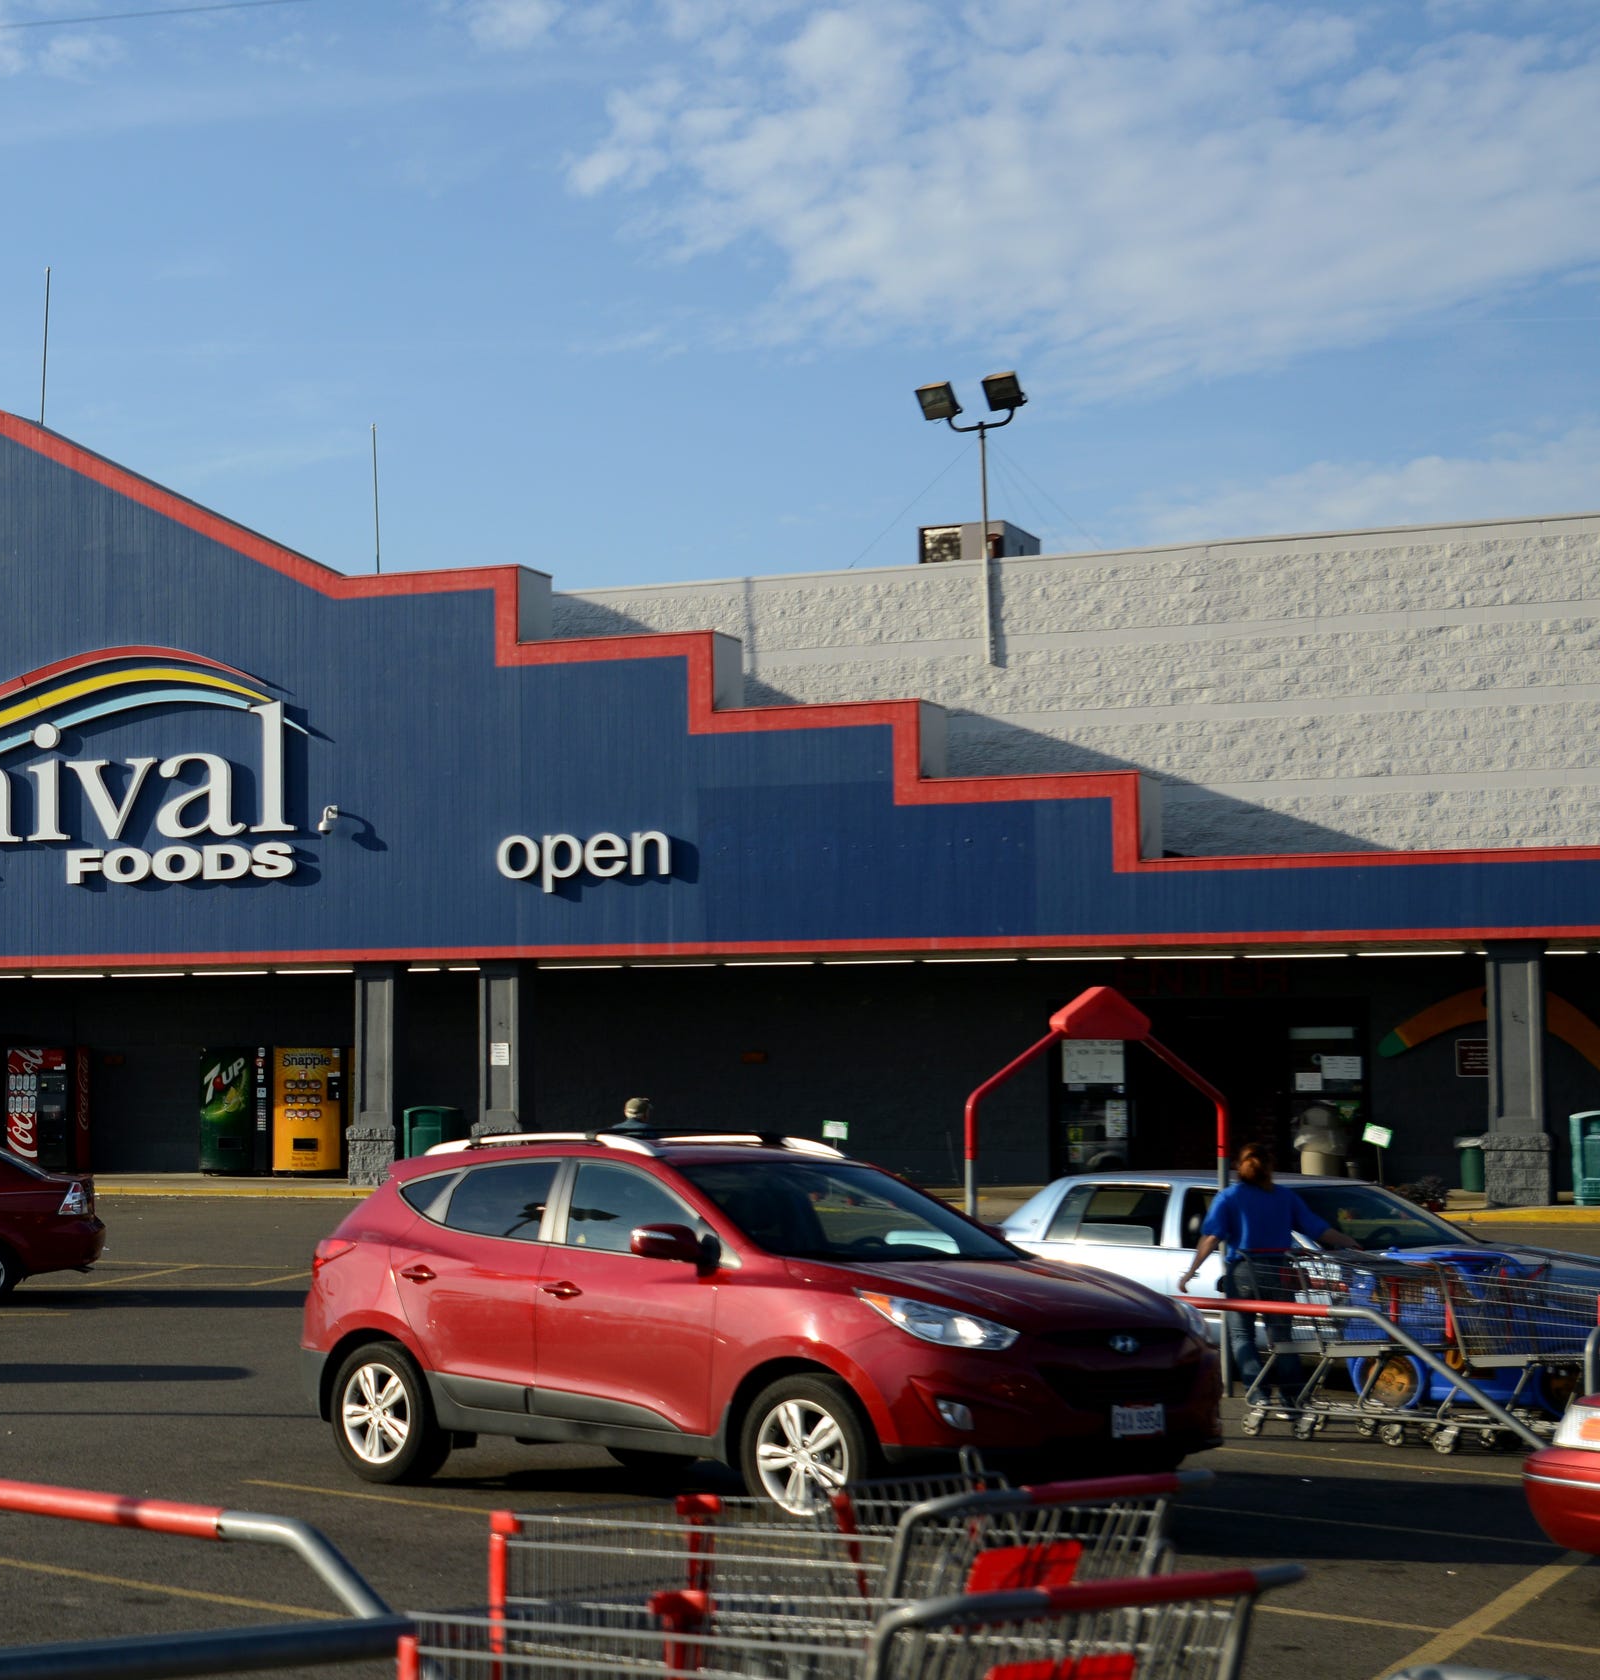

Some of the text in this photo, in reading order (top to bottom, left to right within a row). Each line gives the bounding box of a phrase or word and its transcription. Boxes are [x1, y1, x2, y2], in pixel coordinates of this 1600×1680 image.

[66, 842, 296, 885] FOODS
[496, 830, 671, 894] open
[1117, 959, 1291, 996] ENTER
[282, 1053, 332, 1069] Snapple
